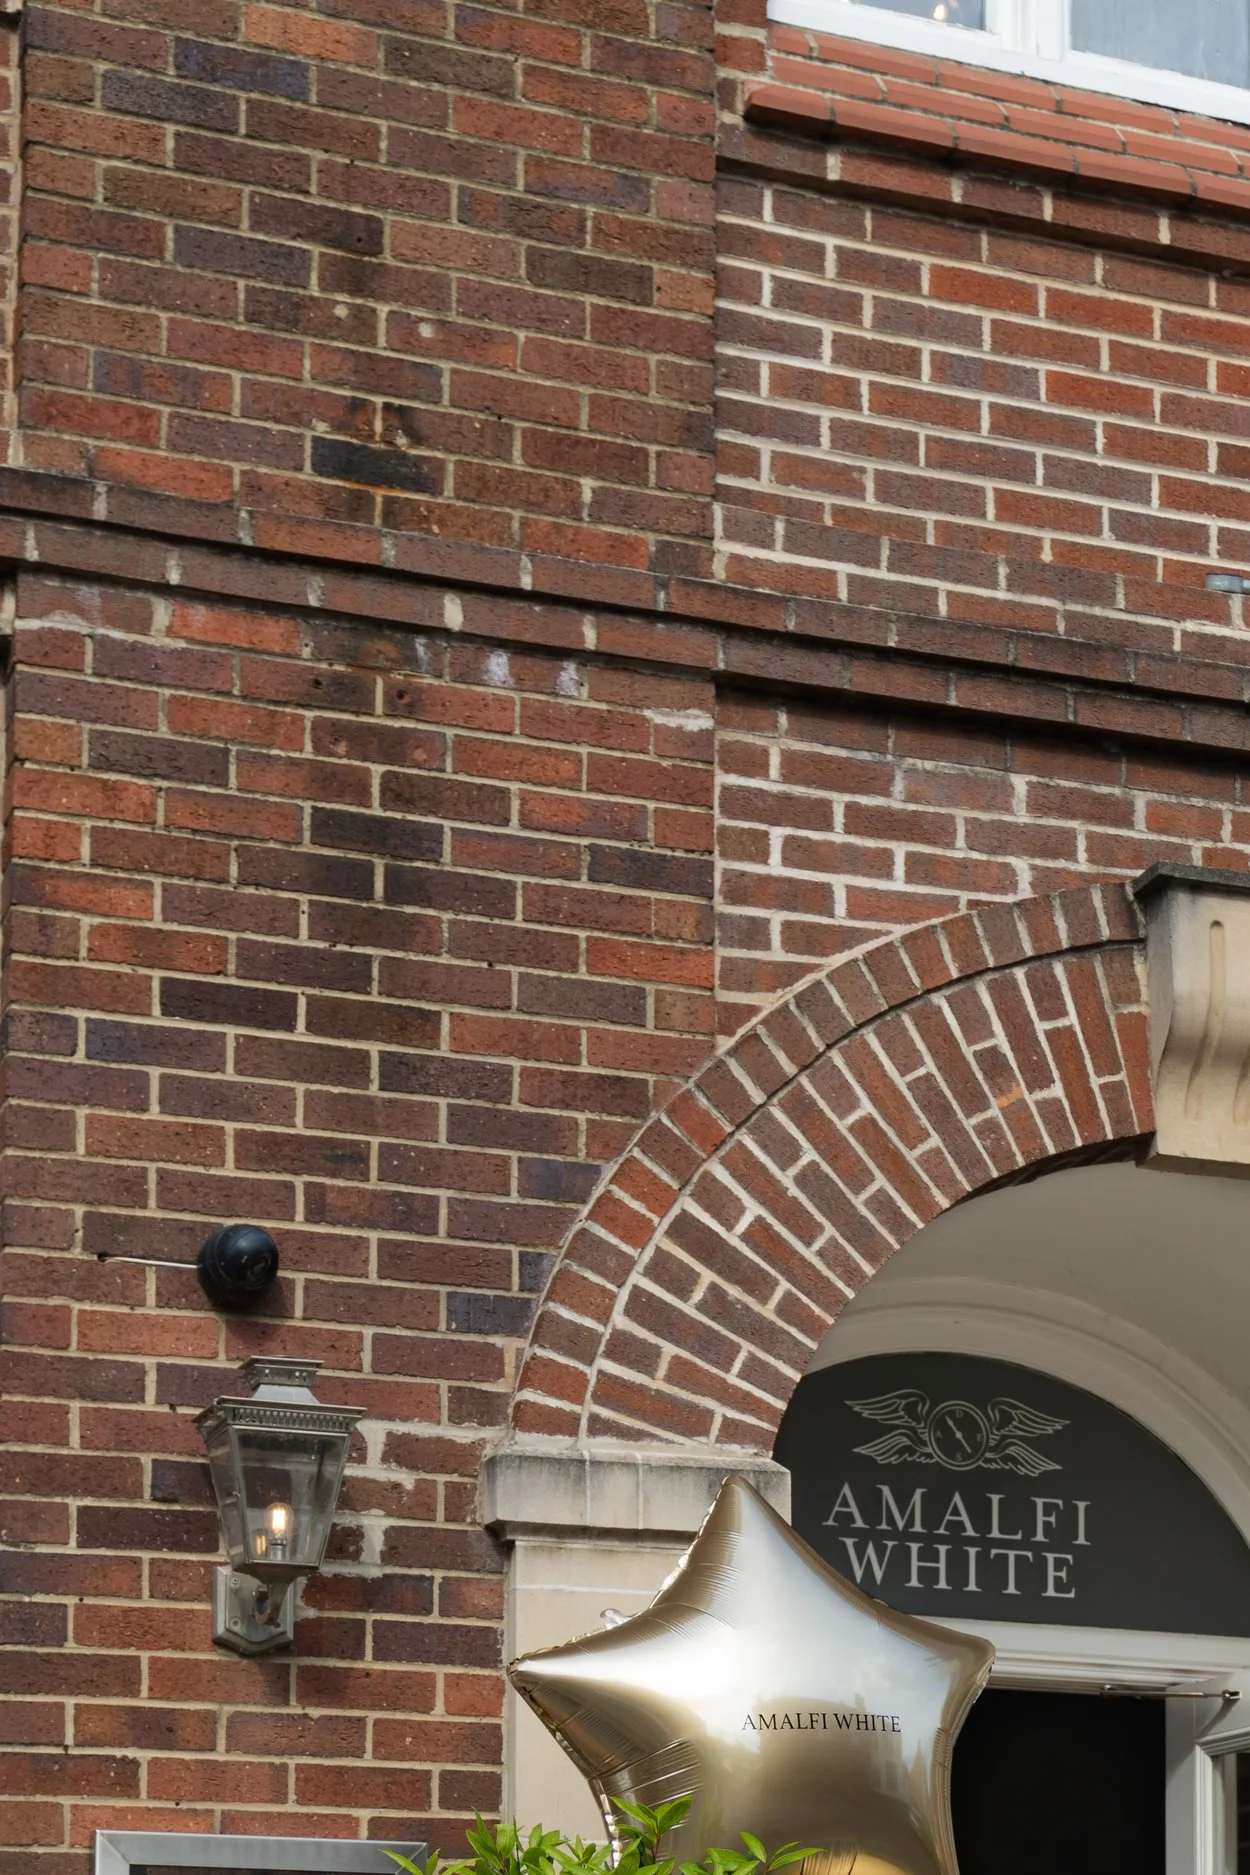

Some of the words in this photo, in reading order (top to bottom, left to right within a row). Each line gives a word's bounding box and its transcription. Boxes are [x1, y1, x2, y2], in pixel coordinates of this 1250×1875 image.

[822, 1481, 1092, 1546] AMALFI
[838, 1536, 1077, 1599] WHITE
[742, 1712, 828, 1731] AMALFI
[833, 1712, 902, 1733] WHITE
